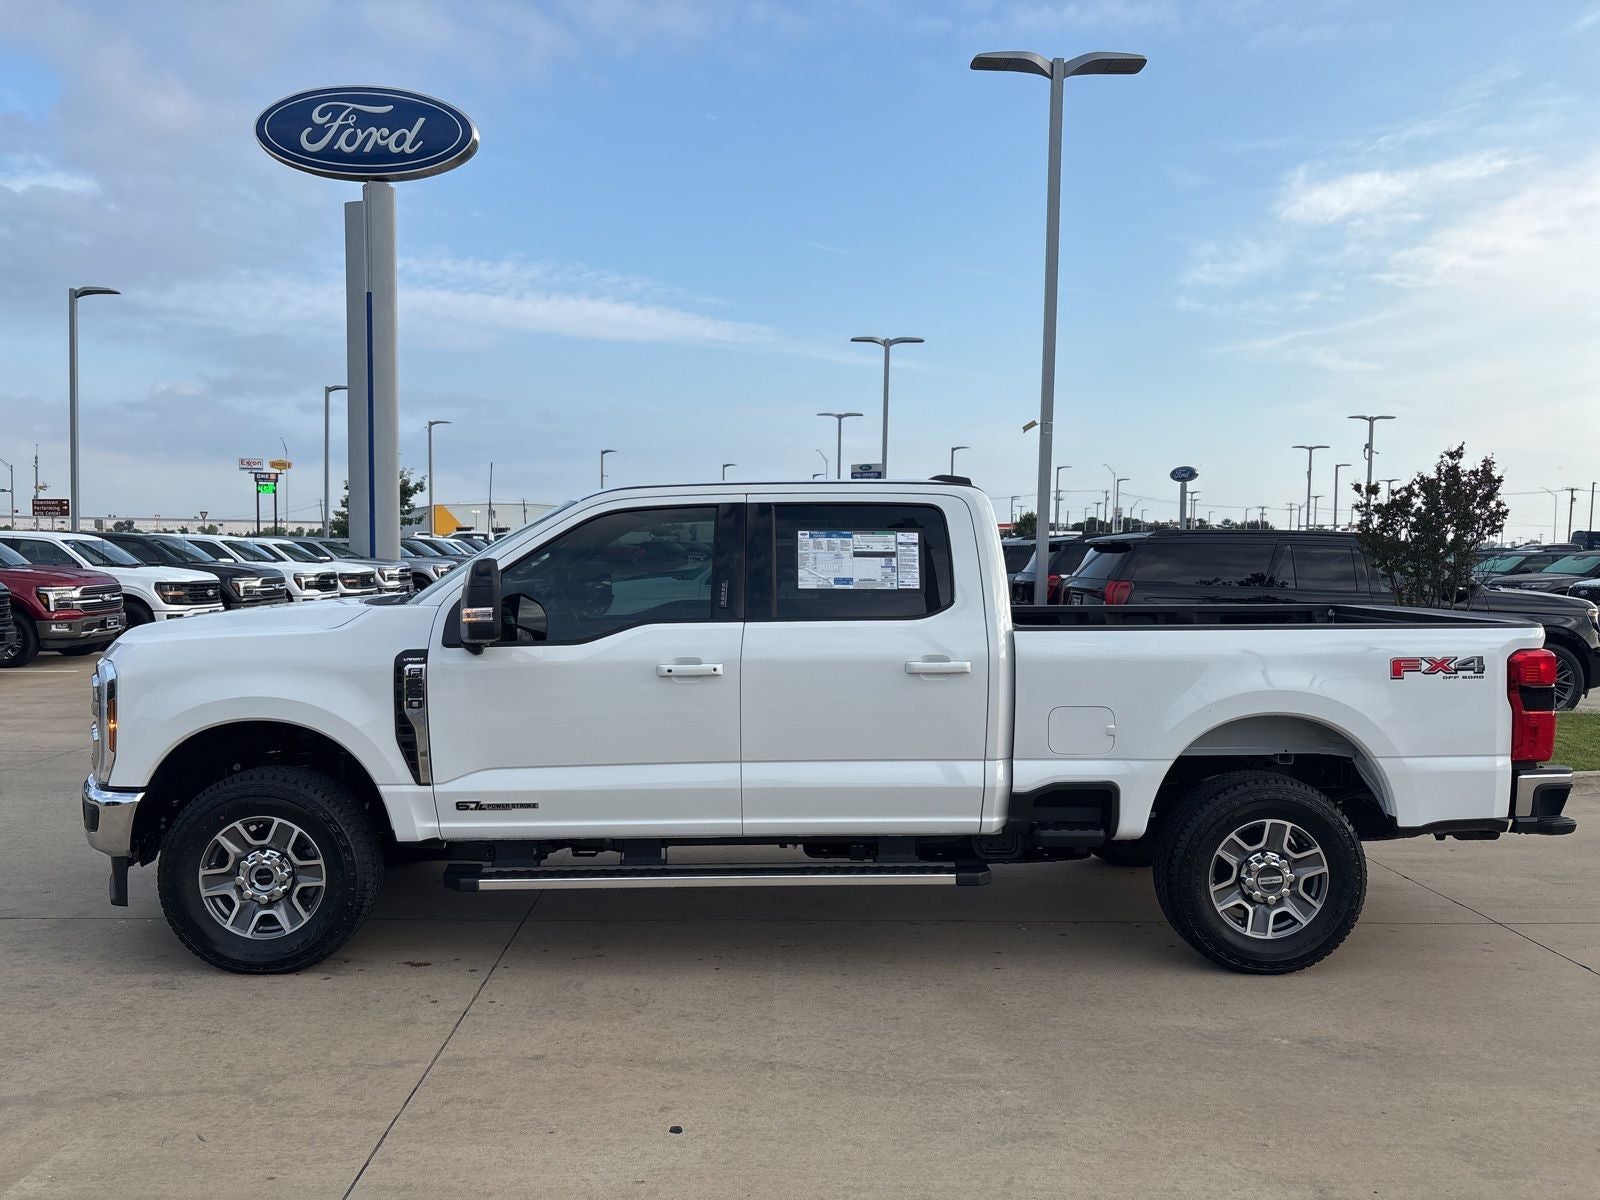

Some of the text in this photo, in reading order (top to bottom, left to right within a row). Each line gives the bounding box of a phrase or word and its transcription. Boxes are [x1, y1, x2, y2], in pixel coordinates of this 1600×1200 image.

[300, 101, 426, 154] Ford
[1389, 655, 1486, 680] FX4
[455, 800, 487, 811] 6.7L
